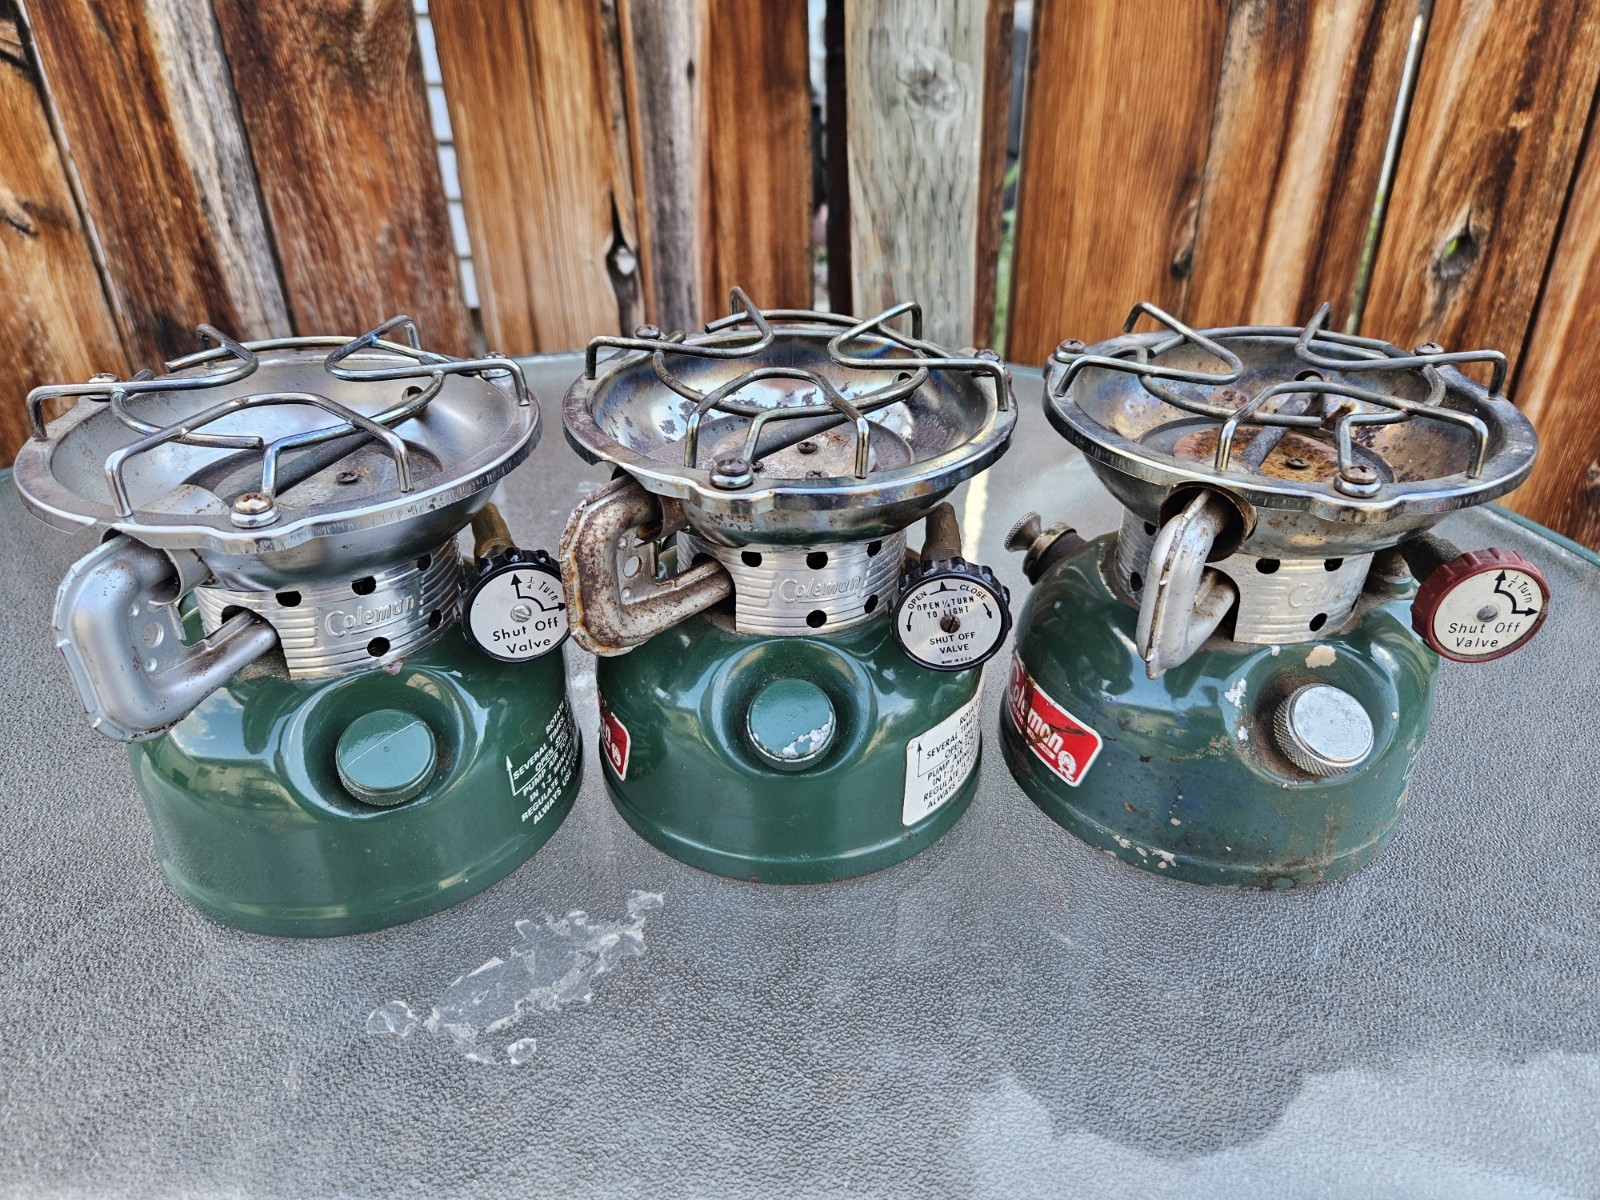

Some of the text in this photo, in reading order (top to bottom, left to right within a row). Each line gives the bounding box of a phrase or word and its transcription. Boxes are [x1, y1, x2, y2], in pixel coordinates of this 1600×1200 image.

[538, 581, 559, 602] Turn
[778, 574, 862, 604] Coleman
[959, 584, 987, 601] CLOSE
[1517, 581, 1533, 604] Turn
[907, 590, 928, 610] OPEN
[916, 600, 940, 612] OPEN
[951, 595, 975, 606] TURN
[325, 594, 415, 638] Coleman
[926, 605, 970, 619] TO LIGHT
[492, 617, 559, 642] Shut Off
[1448, 621, 1521, 634] Shut Off
[506, 638, 551, 655] Valve
[929, 631, 976, 646] SHUT OFF
[939, 643, 970, 655] VALVE
[1455, 637, 1499, 648] Valve
[926, 731, 959, 760] SEVERAL
[944, 738, 962, 759] OPEN
[512, 742, 548, 781] SEVERAL
[534, 746, 554, 772] OPEN
[522, 768, 547, 796] PUMP
[548, 751, 560, 770] AIR
[927, 759, 950, 781] PUMP
[932, 775, 942, 787] IN
[521, 776, 560, 823] REGULATE
[529, 790, 539, 802] IN
[533, 787, 563, 825] ALWAYS
